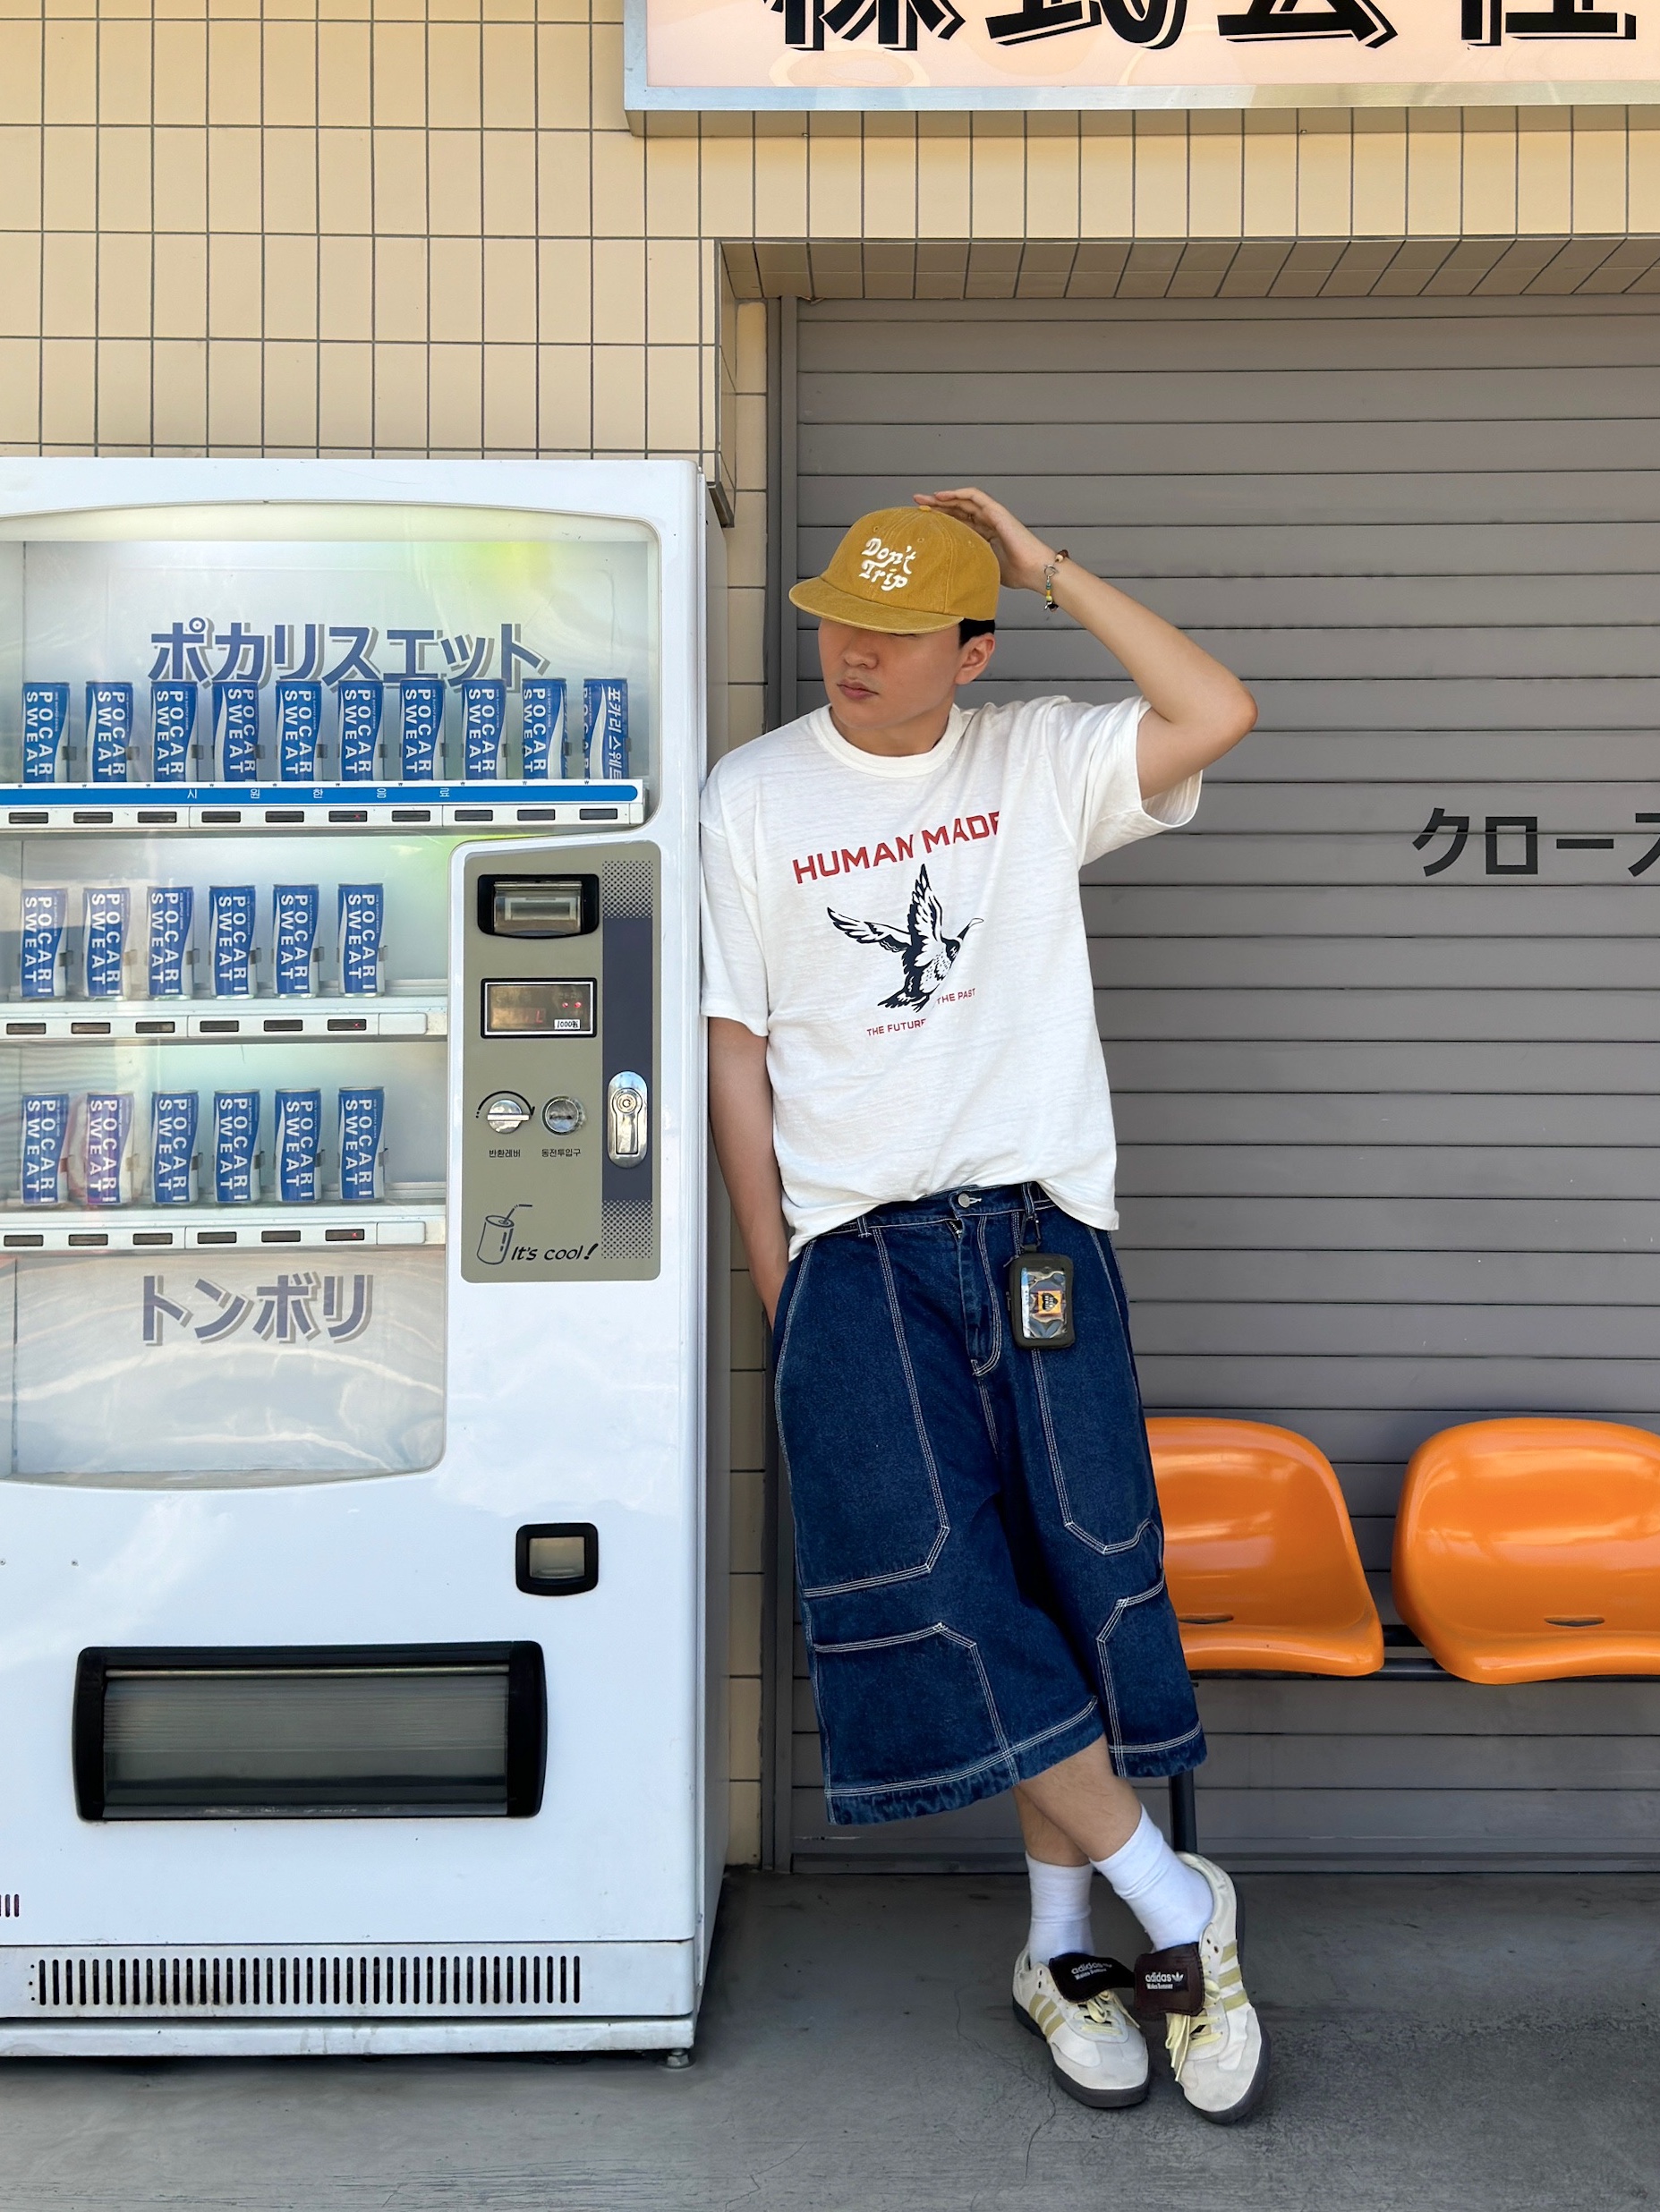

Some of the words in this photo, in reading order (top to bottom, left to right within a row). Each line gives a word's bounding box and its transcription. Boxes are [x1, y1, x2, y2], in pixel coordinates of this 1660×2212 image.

[859, 559, 908, 591] Trip
[861, 538, 916, 574] Don't
[148, 617, 547, 691] ポカリスエット
[26, 691, 38, 777] SWEAT
[98, 691, 112, 777] SWEAT
[157, 691, 169, 775] SWEAT
[170, 691, 184, 783] POCAR
[228, 688, 243, 773] SWEAT
[243, 688, 256, 782] POCAR
[285, 690, 299, 774] SWEAT
[299, 690, 312, 782] POCAR
[345, 689, 357, 774] SWEAT
[358, 689, 371, 781] POCAR
[405, 688, 418, 773] SWEAT
[418, 688, 431, 781] POCAR
[469, 688, 481, 772] SWEAT
[482, 688, 496, 780] POCAR
[533, 687, 547, 780] POCAR
[792, 834, 914, 884] HUMAN
[25, 897, 38, 983] SWEAT
[38, 897, 52, 992] POCARI
[92, 894, 106, 984] SWEAT
[106, 894, 120, 994] POCARI
[151, 893, 164, 983] SWEAT
[165, 893, 179, 993] POCARI
[218, 897, 233, 981] SWEAT
[233, 897, 247, 991] POCARI
[281, 895, 294, 979] SWEAT
[294, 895, 308, 990] POCARI
[348, 895, 362, 979] SWEAT
[362, 894, 375, 989] POCARI
[866, 1026, 885, 1036] THE
[936, 992, 955, 1004] THE
[958, 988, 976, 1000] PAST
[27, 1101, 40, 1192] SWEAT
[40, 1101, 55, 1203] POCARI
[89, 1101, 102, 1192] SWEAT
[103, 1100, 117, 1202] POCARI
[158, 1100, 172, 1190] SWEAT
[173, 1100, 187, 1201] POCARI
[220, 1099, 233, 1189] SWEAT
[234, 1098, 248, 1200] POCARI
[286, 1102, 300, 1187] SWEAT
[301, 1101, 313, 1197] POCARI
[345, 1100, 358, 1185] SWEAT
[359, 1099, 372, 1195] POCARI
[489, 1149, 521, 1158] 반환레버
[541, 1148, 581, 1158] 동전투입구
[511, 1246, 538, 1261] It's
[544, 1243, 599, 1261] cool!
[141, 1272, 374, 1347] トンボリ
